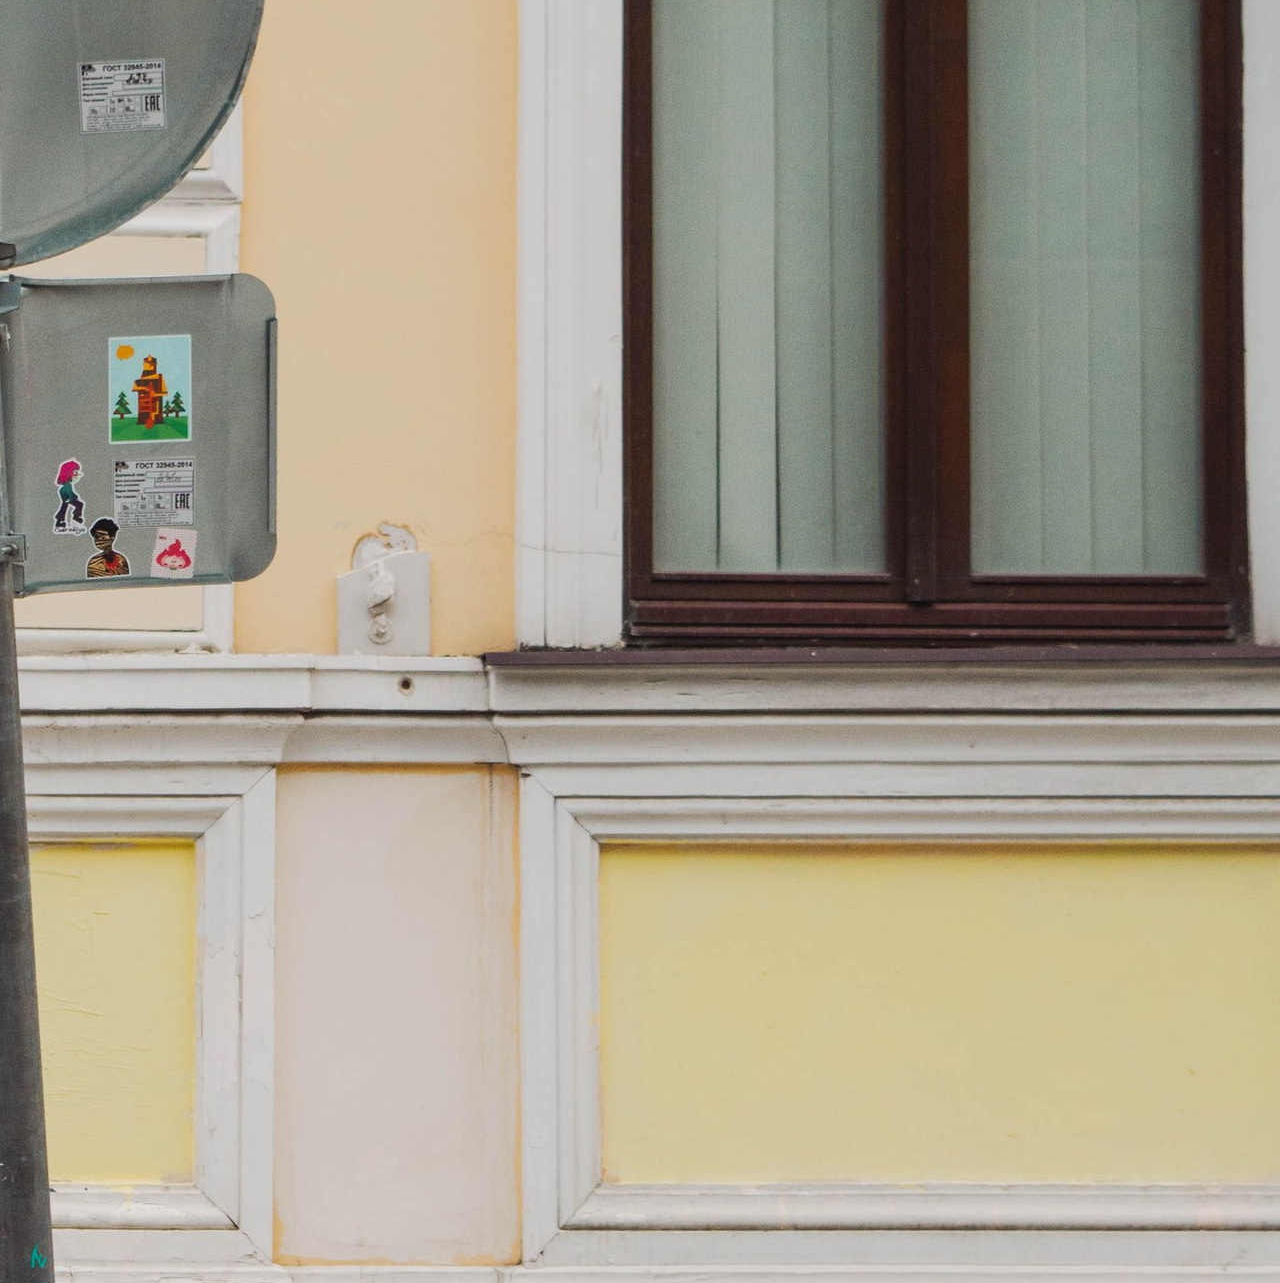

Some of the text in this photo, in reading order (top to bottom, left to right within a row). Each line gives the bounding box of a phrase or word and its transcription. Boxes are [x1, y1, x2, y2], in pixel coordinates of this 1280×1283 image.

[102, 65, 122, 73] ГОСТ
[145, 95, 161, 112] EAC
[175, 493, 190, 509] EAC
